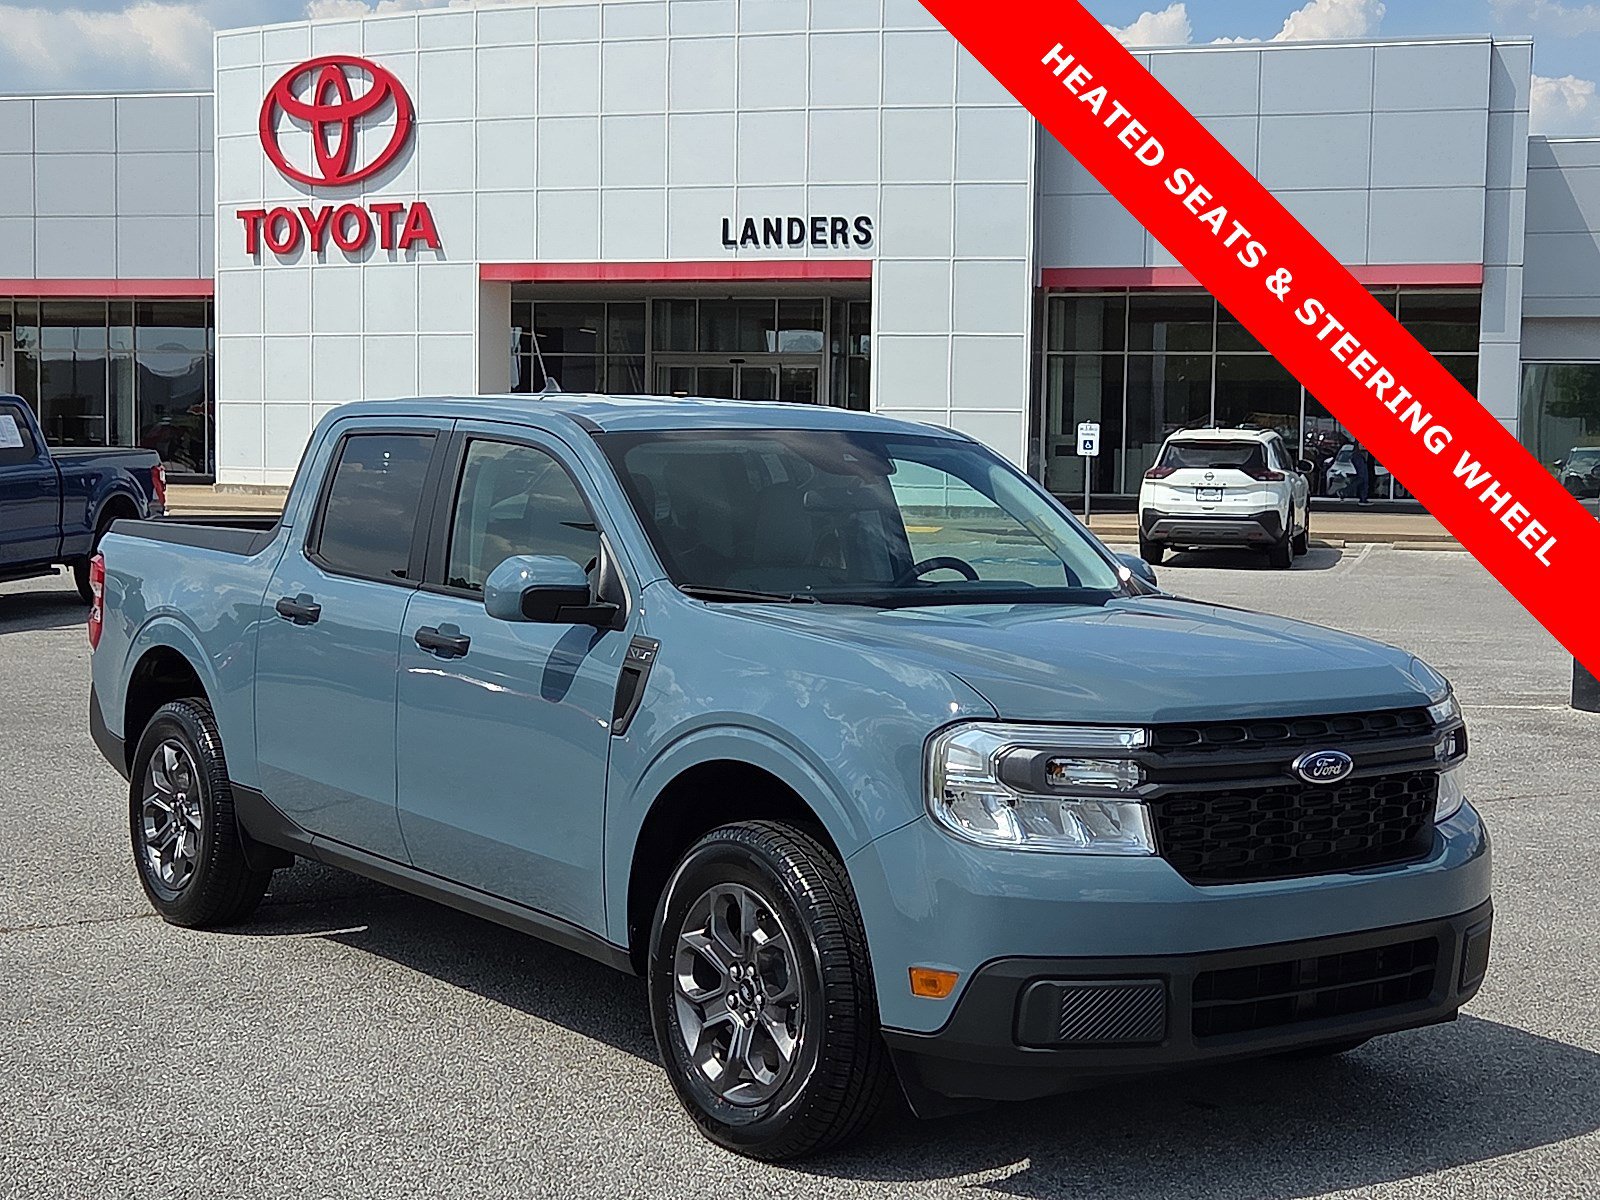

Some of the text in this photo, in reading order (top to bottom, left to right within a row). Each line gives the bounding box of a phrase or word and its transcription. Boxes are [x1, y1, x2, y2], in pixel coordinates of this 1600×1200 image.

[236, 201, 439, 255] TOYOTA
[721, 215, 873, 246] LANDERS
[1313, 757, 1343, 777] Ford
